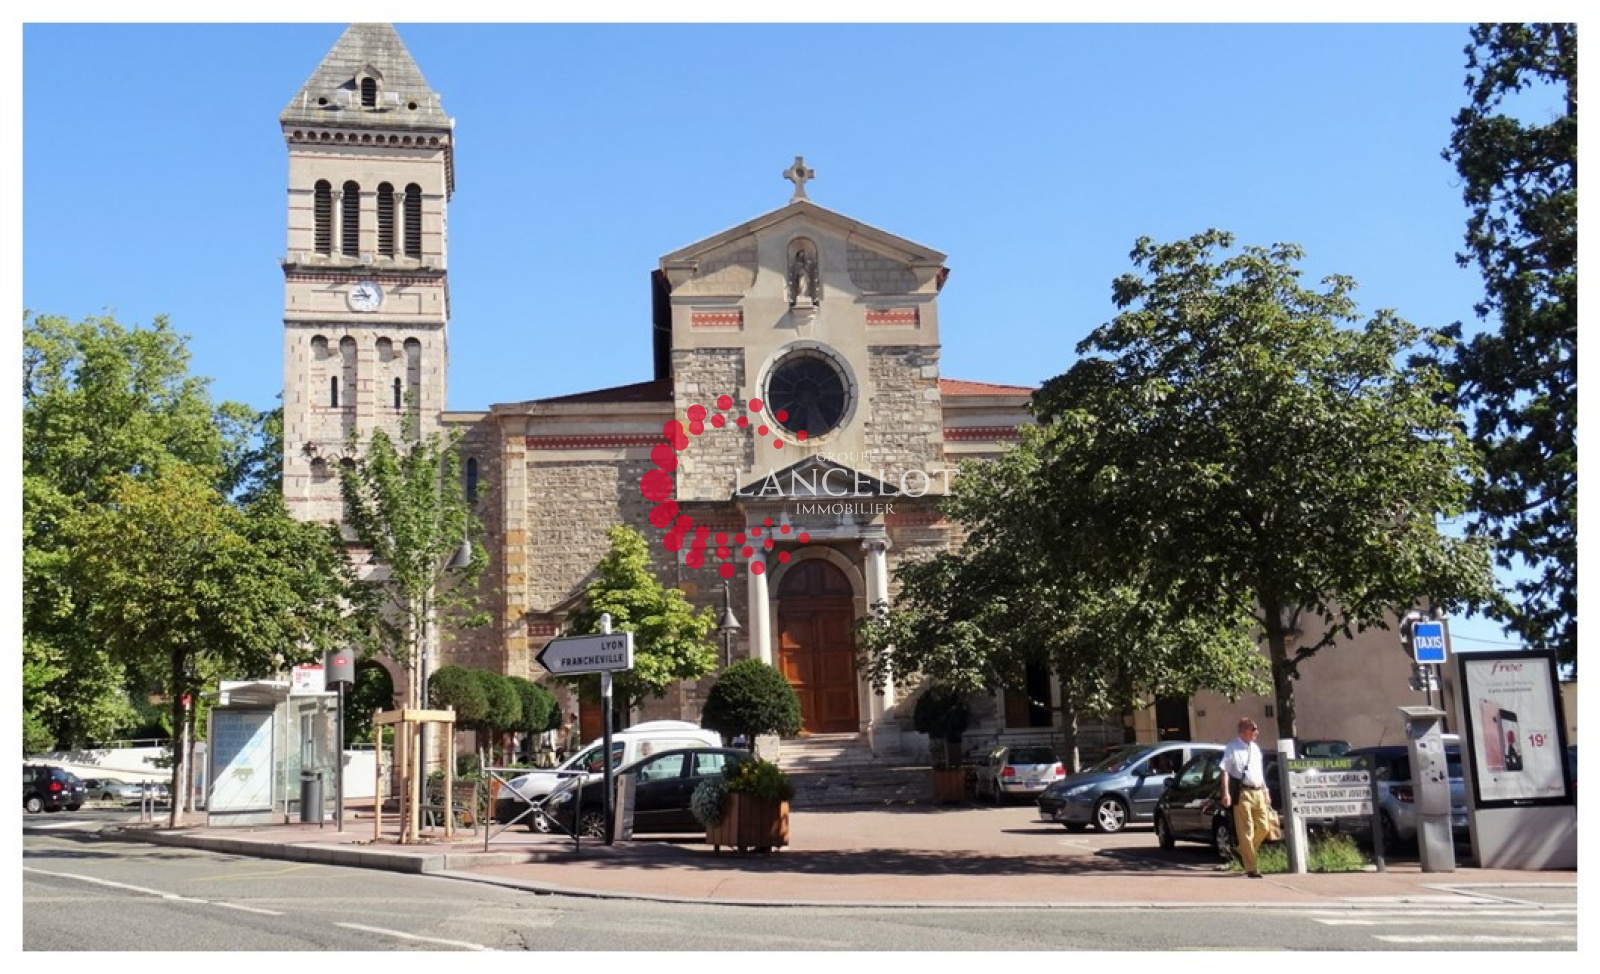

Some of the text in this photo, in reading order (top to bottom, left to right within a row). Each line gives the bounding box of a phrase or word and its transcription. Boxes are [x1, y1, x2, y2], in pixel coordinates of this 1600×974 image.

[601, 641, 624, 650] LYON
[1416, 636, 1442, 648] TAXIS
[561, 653, 624, 667] FRANCHEVILLE
[1491, 661, 1523, 675] free
[1329, 773, 1361, 782] NOTARIAL
[1330, 789, 1346, 798] SAINT
[1348, 789, 1371, 797] JOSEPH
